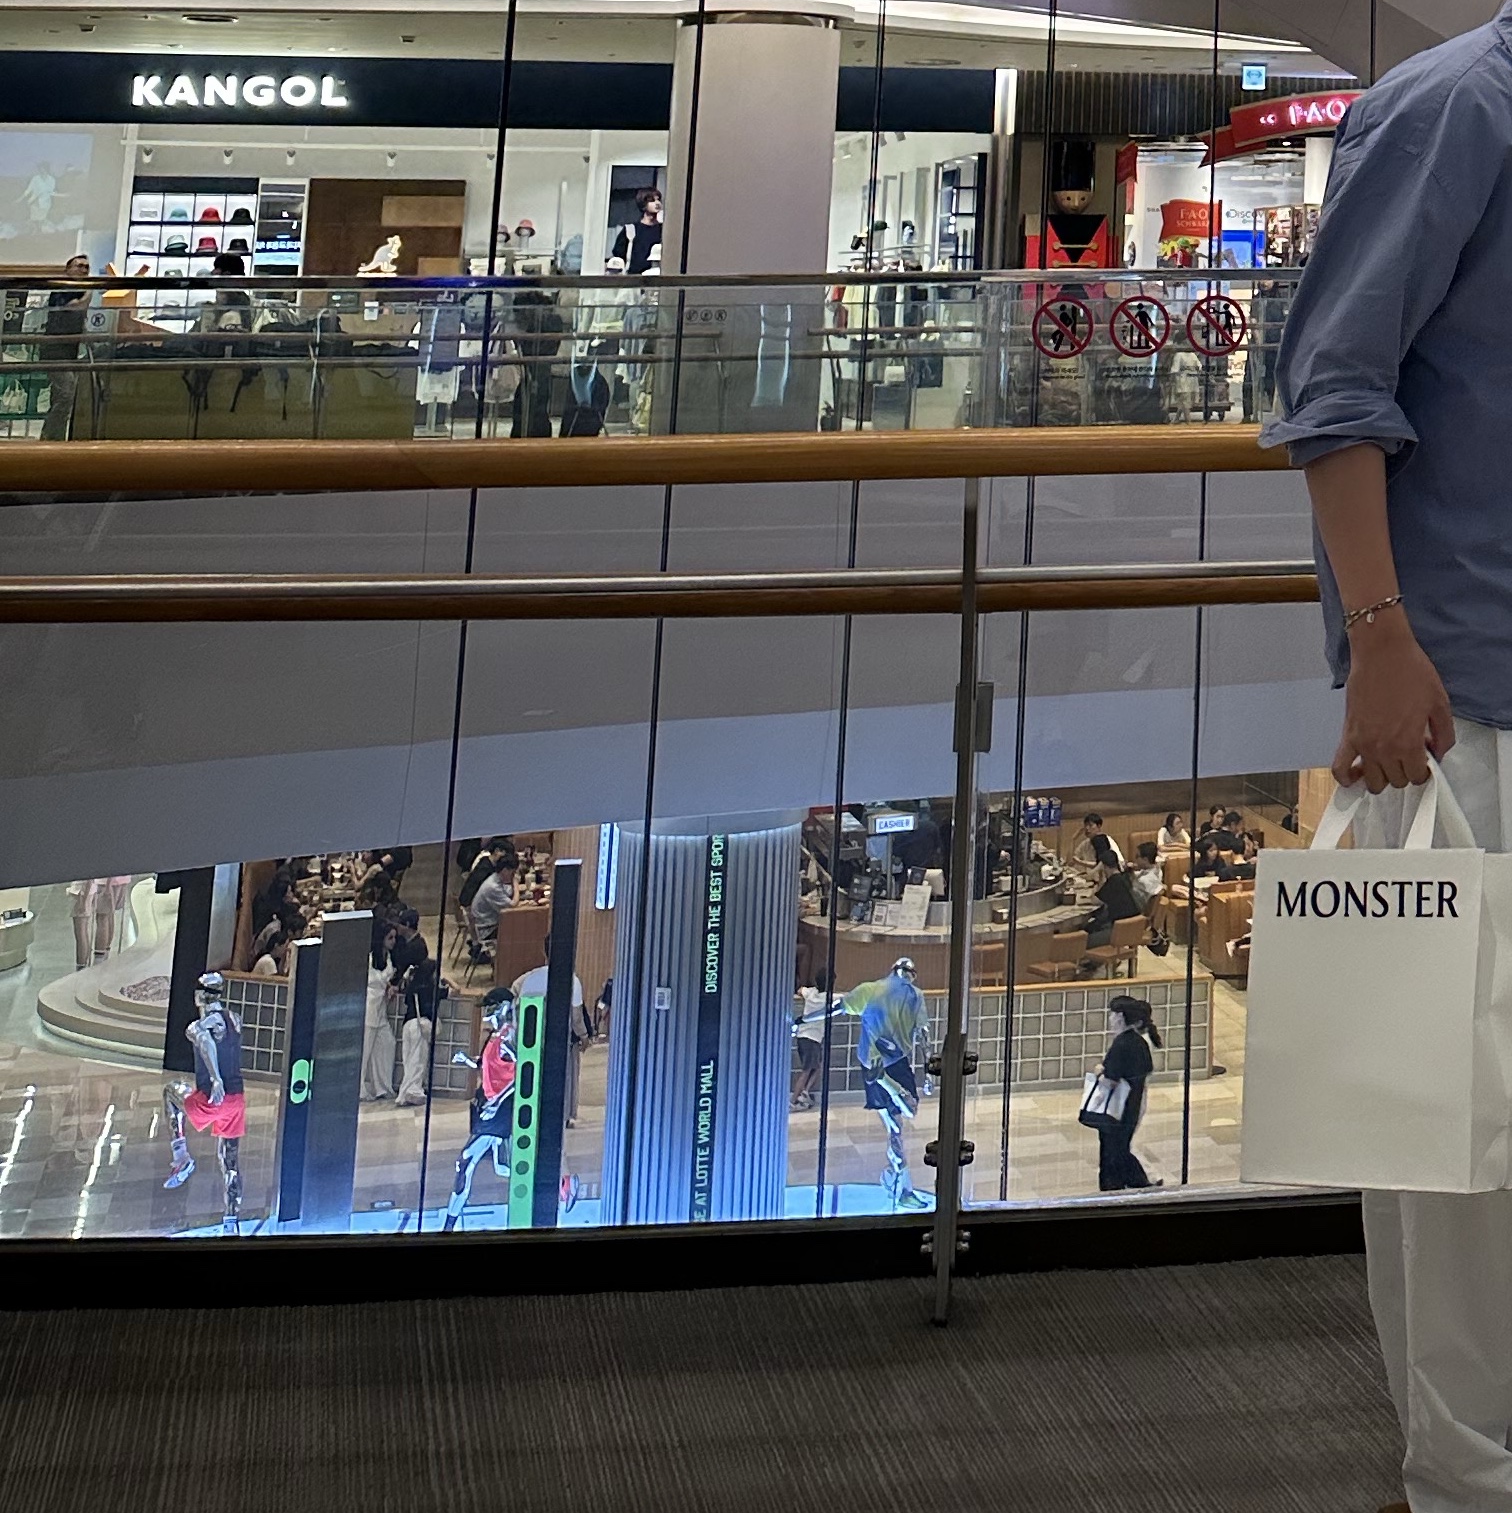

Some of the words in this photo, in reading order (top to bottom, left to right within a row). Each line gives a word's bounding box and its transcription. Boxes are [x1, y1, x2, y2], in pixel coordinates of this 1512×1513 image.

[131, 74, 348, 107] KANGOL
[709, 870, 723, 902] BEST
[1276, 880, 1459, 918] MONSTER
[708, 905, 722, 930] THE
[705, 933, 720, 994] DISCOVER
[700, 1059, 714, 1094] MALL
[697, 1097, 712, 1144] WORLD
[695, 1146, 710, 1187] LOTTE
[694, 1191, 708, 1206] AT
